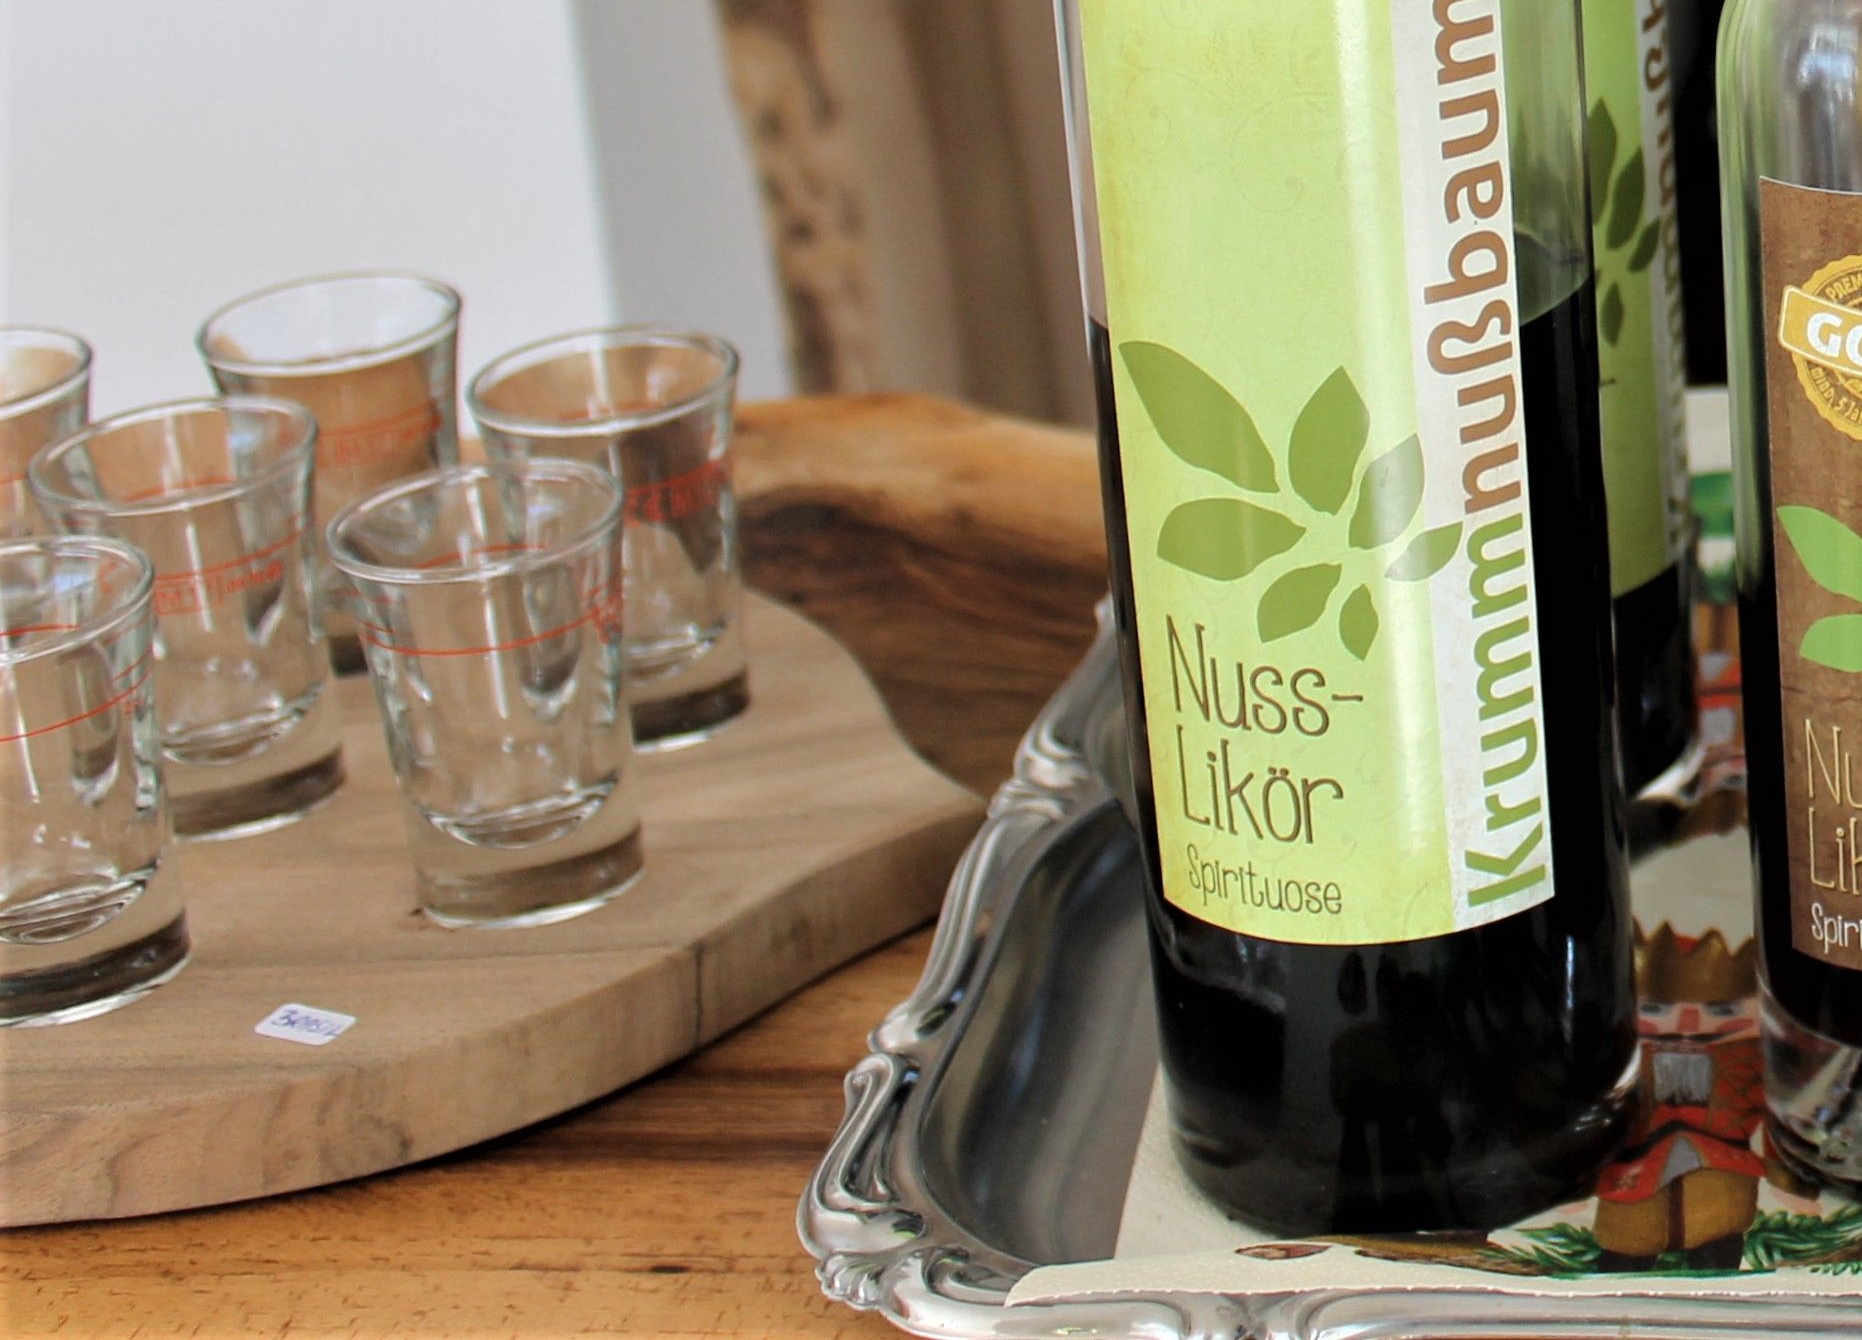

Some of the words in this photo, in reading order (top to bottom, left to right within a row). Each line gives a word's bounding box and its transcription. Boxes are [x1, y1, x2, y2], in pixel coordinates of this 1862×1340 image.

[1166, 613, 1364, 737] Nuss-
[1175, 724, 1344, 844] Likör
[1187, 842, 1343, 915] Spirituose
